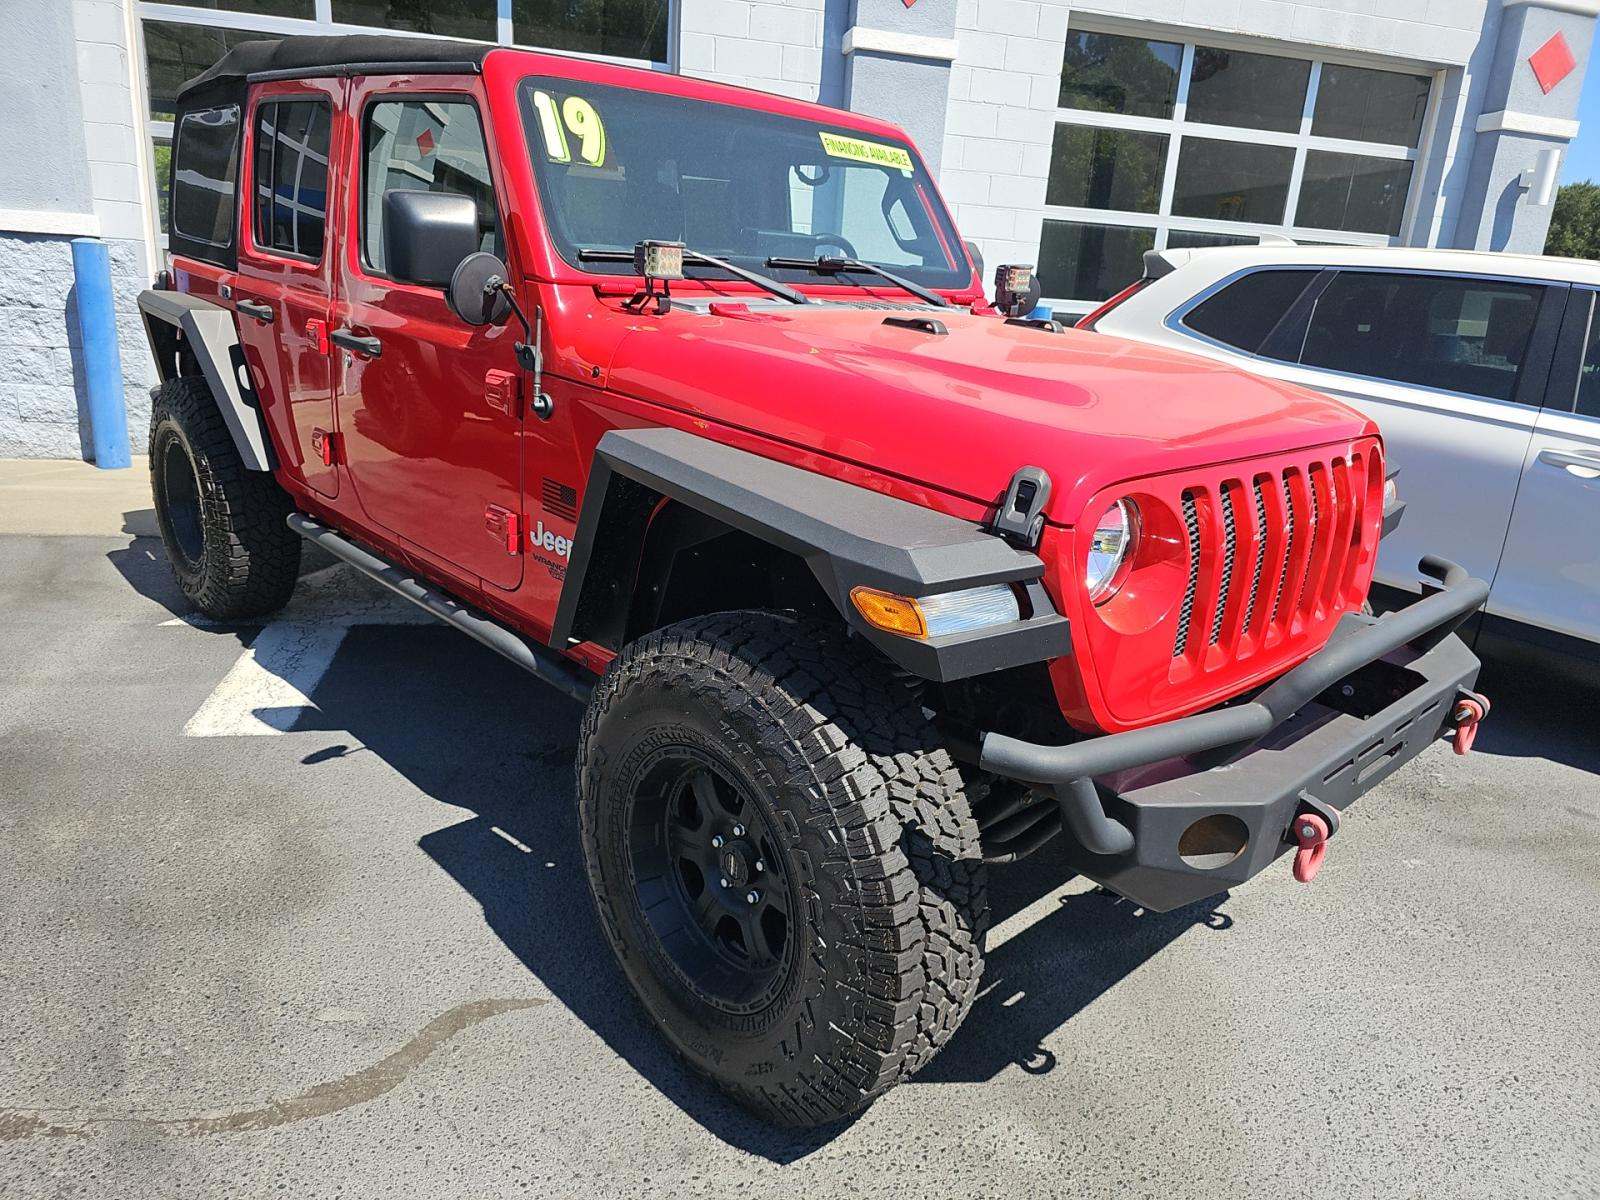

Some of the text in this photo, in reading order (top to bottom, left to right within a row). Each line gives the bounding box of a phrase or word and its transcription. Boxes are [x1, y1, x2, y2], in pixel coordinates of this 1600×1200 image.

[533, 91, 606, 167] 19
[824, 137, 910, 168] FINANCING AVAILABLE
